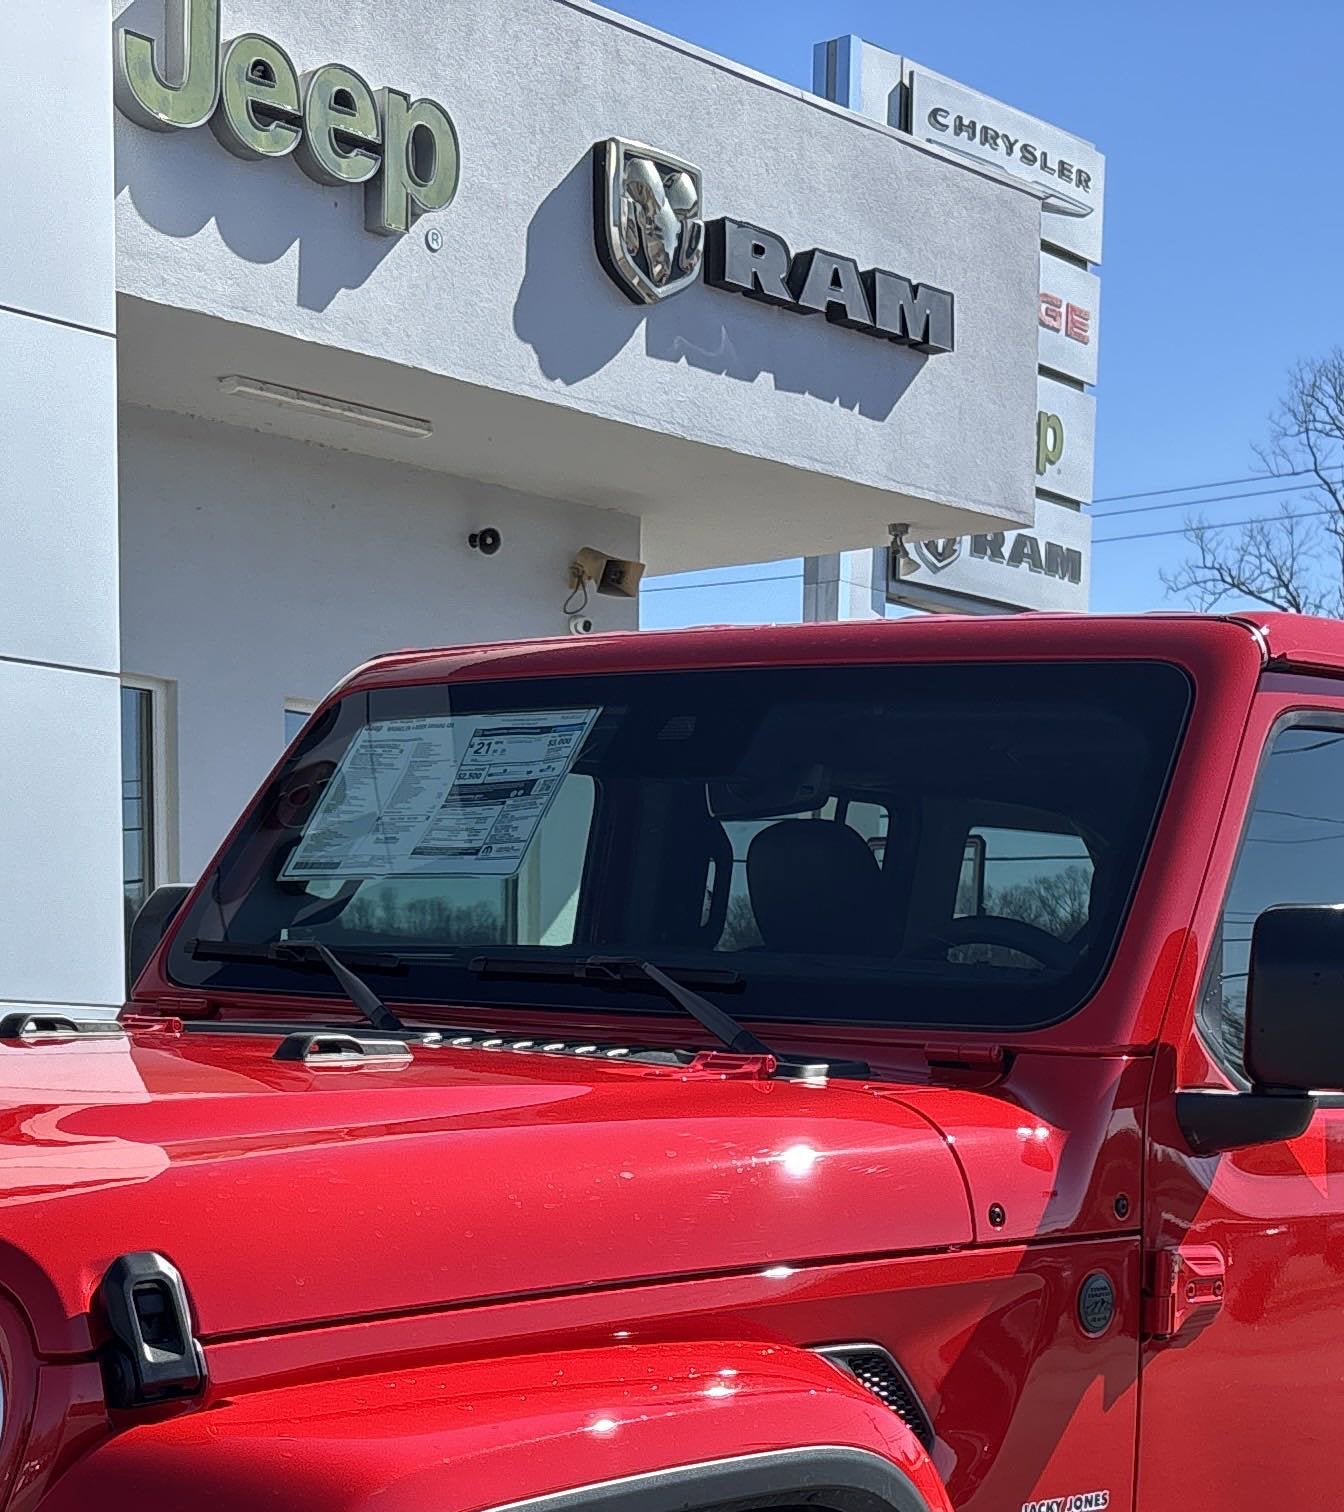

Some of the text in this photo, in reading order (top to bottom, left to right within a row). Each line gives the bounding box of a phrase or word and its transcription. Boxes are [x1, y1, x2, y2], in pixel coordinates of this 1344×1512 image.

[115, 0, 460, 234] Jeep
[928, 107, 1092, 193] CHRYSLER
[704, 217, 955, 355] RAM
[969, 531, 1082, 584] RAM
